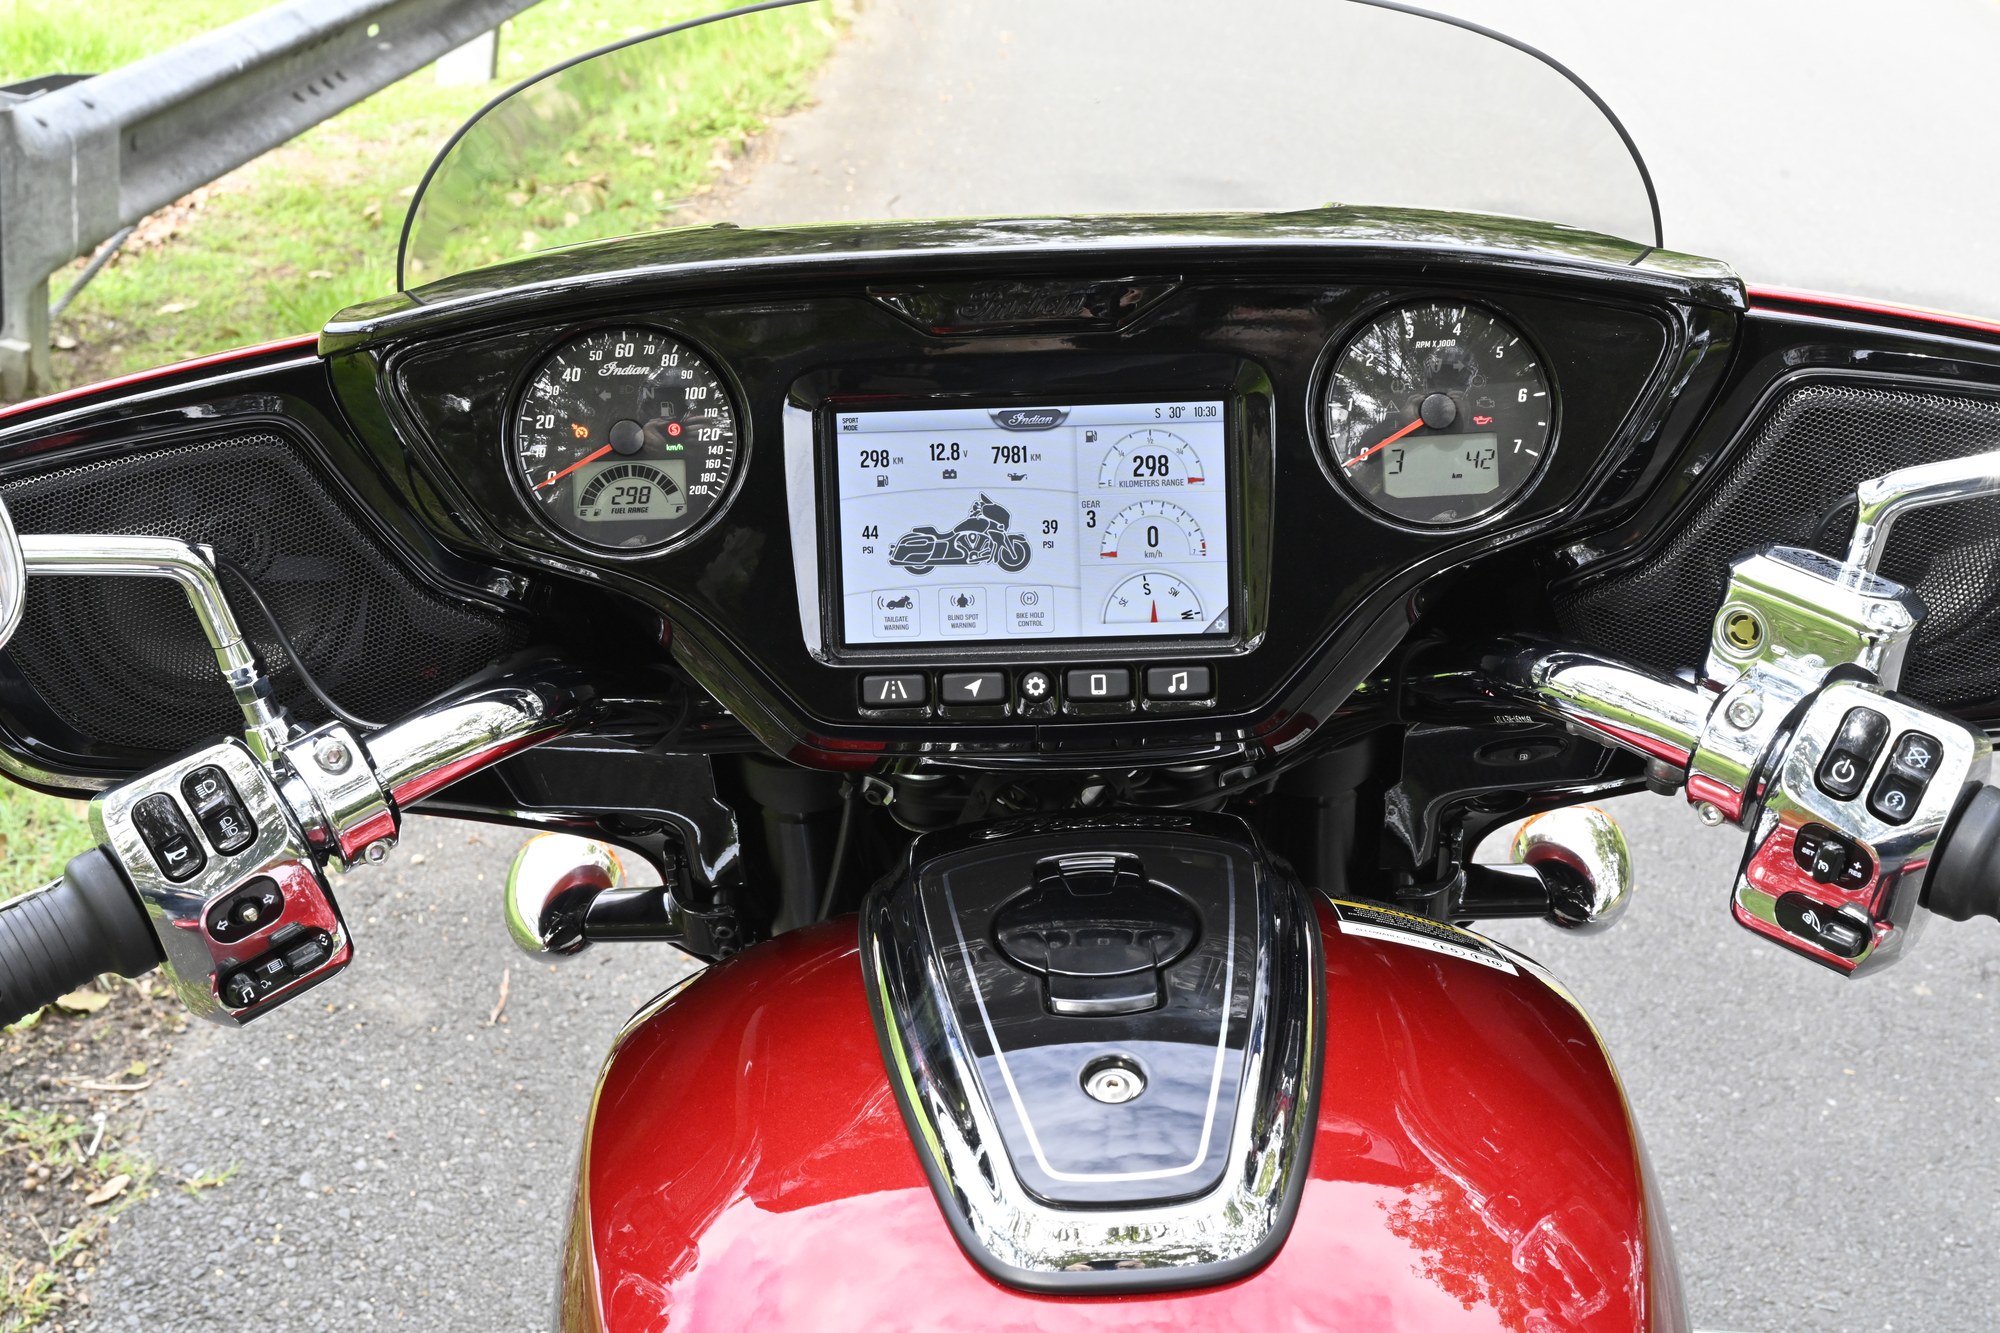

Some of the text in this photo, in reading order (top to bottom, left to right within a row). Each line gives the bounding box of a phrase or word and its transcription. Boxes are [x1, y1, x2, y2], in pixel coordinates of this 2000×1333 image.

[1405, 324, 1414, 339] 3
[1452, 323, 1461, 336] 4
[1439, 339, 1456, 348] 1000
[589, 350, 602, 361] 50
[615, 343, 634, 357] 60
[643, 345, 655, 355] 70
[1495, 346, 1504, 358] 5
[661, 353, 678, 367] 80
[1366, 353, 1374, 366] 2
[562, 367, 581, 382] 40
[598, 361, 651, 377] Indian
[680, 370, 693, 380] 90
[643, 388, 655, 399] N
[684, 387, 707, 400] 100
[1518, 388, 1528, 403] 6
[1348, 398, 1353, 411] 1
[704, 408, 718, 418] 110
[1155, 407, 1161, 419] S
[1194, 406, 1217, 417] 10:30
[535, 414, 555, 429] 20
[1008, 412, 1053, 426] Indian
[697, 428, 720, 441] 120
[666, 443, 684, 451] km/h
[708, 445, 723, 455] 140
[929, 442, 960, 462] 12.8
[1513, 439, 1522, 453] 7
[535, 447, 546, 458] 10
[991, 445, 1042, 464] 7981 KM
[1360, 447, 1369, 461] 0
[705, 459, 721, 469] 160
[860, 450, 904, 468] 298 KM
[1388, 449, 1404, 474] 3
[1132, 454, 1169, 477] 298
[547, 471, 557, 485] 0
[700, 473, 716, 482] 180
[1119, 478, 1184, 488] KILOMETERS RANGE
[611, 486, 651, 505] 298
[689, 485, 708, 495] 200
[627, 506, 649, 514] RANGE
[1081, 500, 1101, 508] GEAR
[1086, 510, 1096, 528] 3
[862, 525, 879, 540] 44
[1042, 520, 1058, 535] 39
[1147, 525, 1159, 548] 0
[862, 546, 874, 554] PSI
[1042, 541, 1054, 549] PSI
[1144, 550, 1163, 559] km/h
[1142, 583, 1152, 595] S
[1168, 586, 1180, 598] SW
[1118, 597, 1129, 607] SE
[884, 615, 909, 623] TAILGATE
[964, 613, 979, 621] SPOT
[1029, 611, 1045, 619] HOLD
[884, 623, 909, 631] WARNING
[951, 621, 976, 629] WARNING
[1017, 619, 1044, 627] CONTROL
[1801, 846, 1815, 857] SET
[1848, 868, 1862, 879] RES
